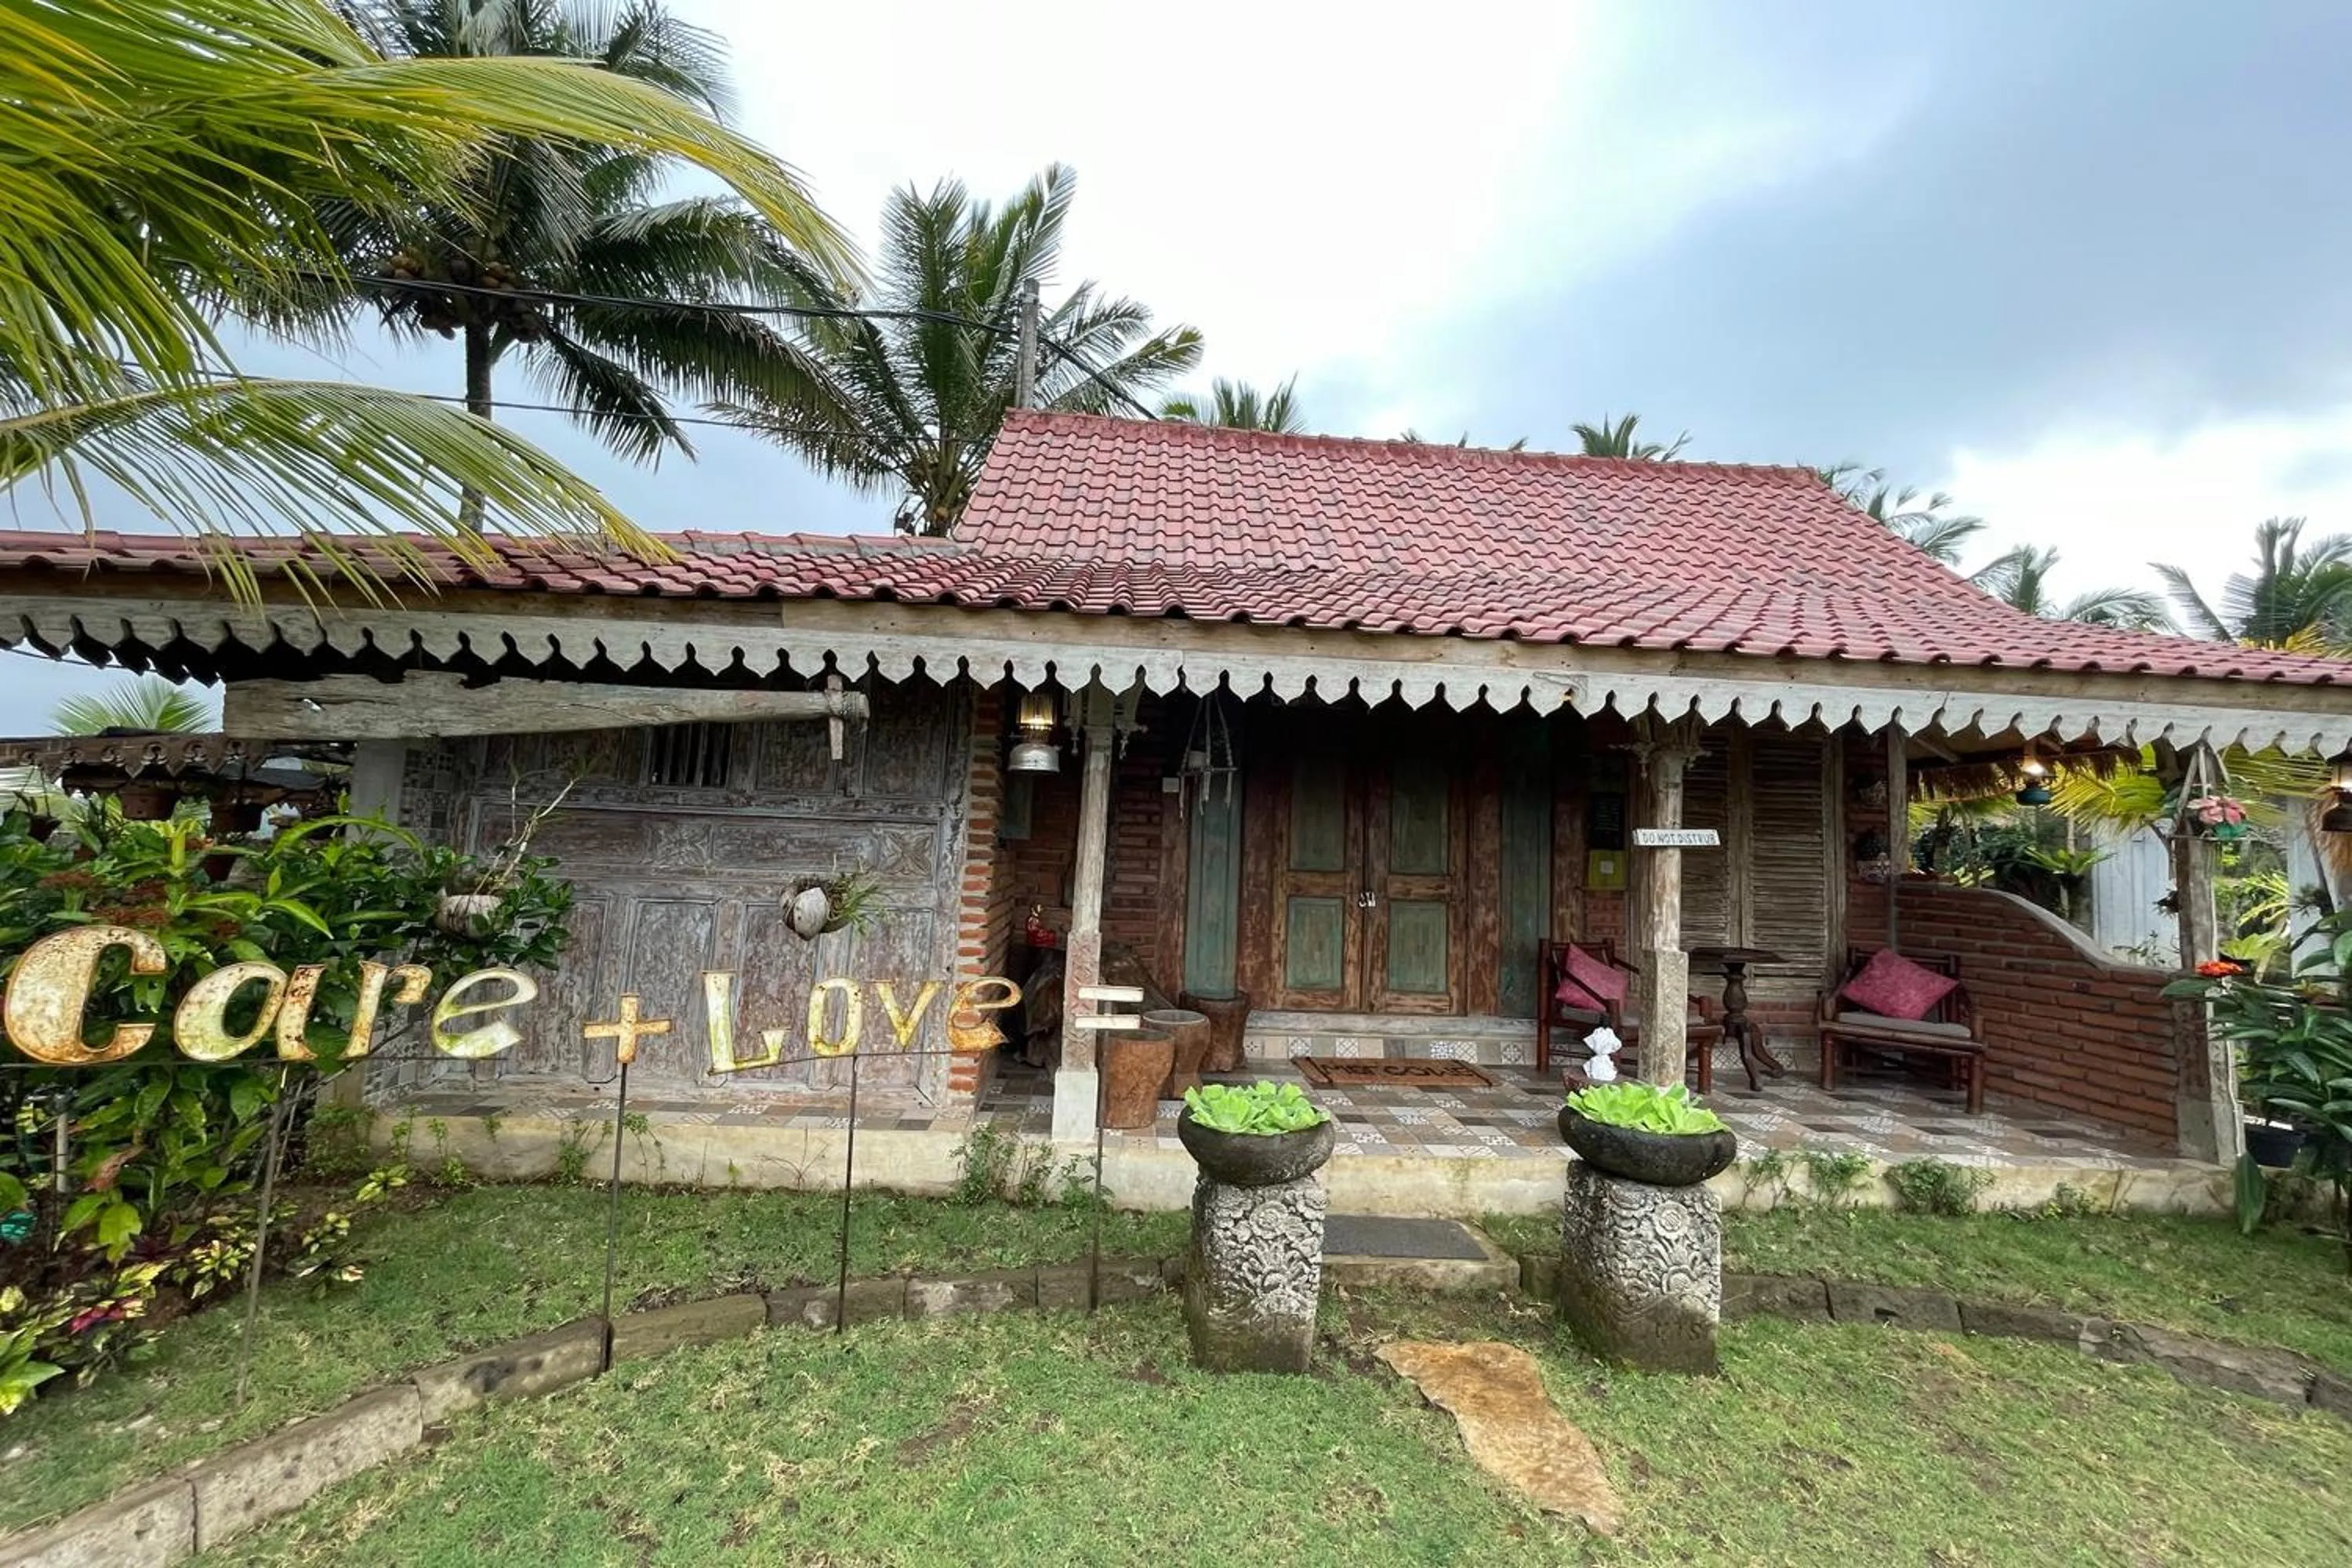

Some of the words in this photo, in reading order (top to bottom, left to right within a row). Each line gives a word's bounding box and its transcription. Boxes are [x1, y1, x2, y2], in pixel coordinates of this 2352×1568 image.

[1642, 833, 1655, 844] DO
[1657, 833, 1675, 844] NOT
[4, 924, 539, 1065] Care
[583, 993, 673, 1064] +
[702, 971, 1023, 1076] Love
